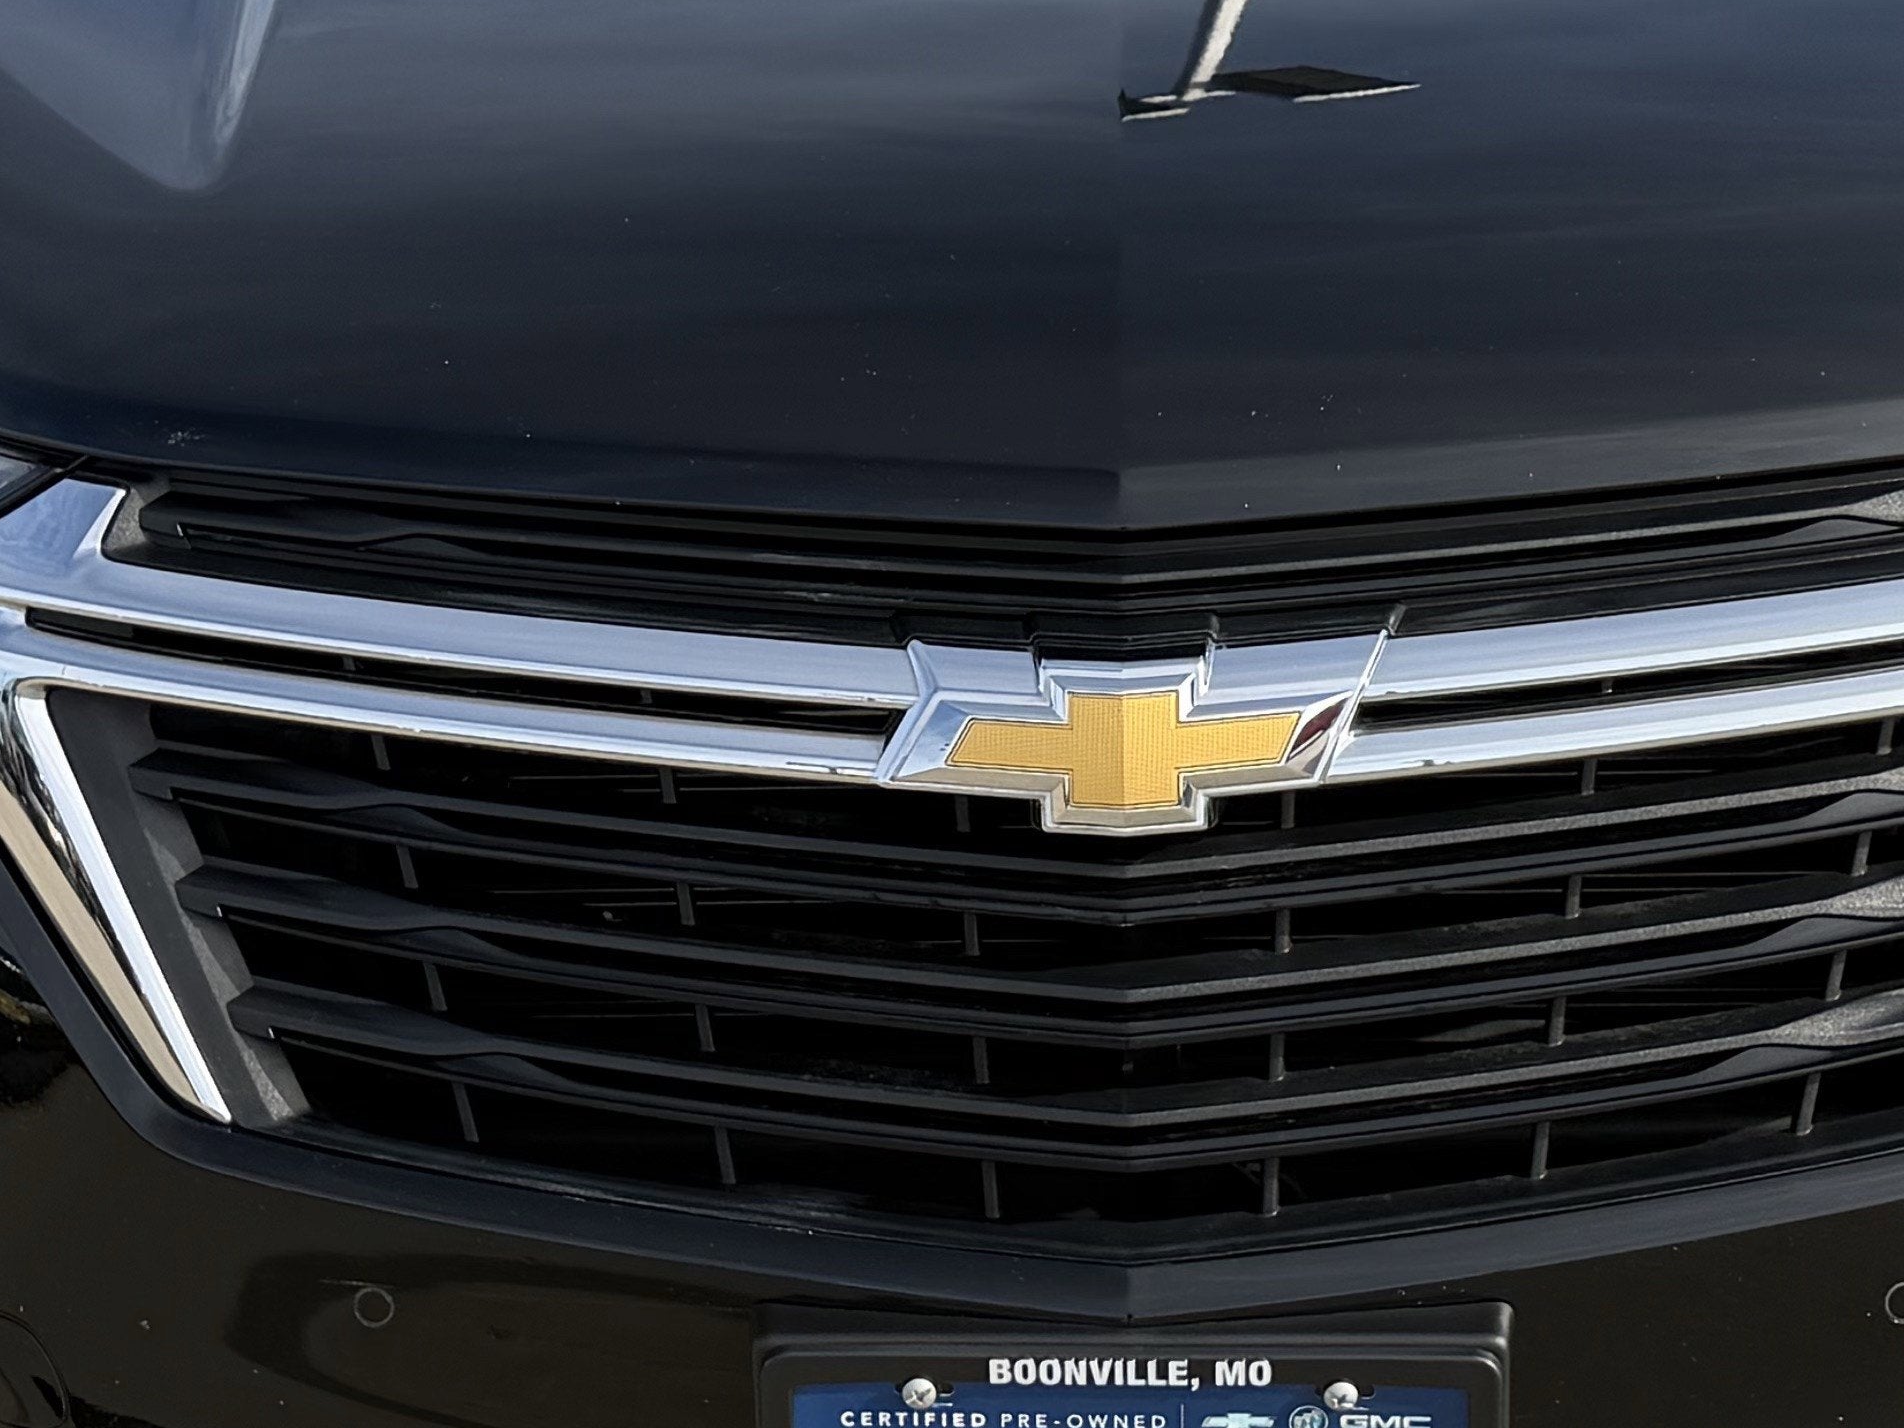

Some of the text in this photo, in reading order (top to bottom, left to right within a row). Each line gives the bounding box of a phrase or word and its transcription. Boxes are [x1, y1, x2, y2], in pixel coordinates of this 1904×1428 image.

[988, 1357, 1273, 1392] BOONVILLE, MO
[840, 1411, 987, 1428] CERTIFIED
